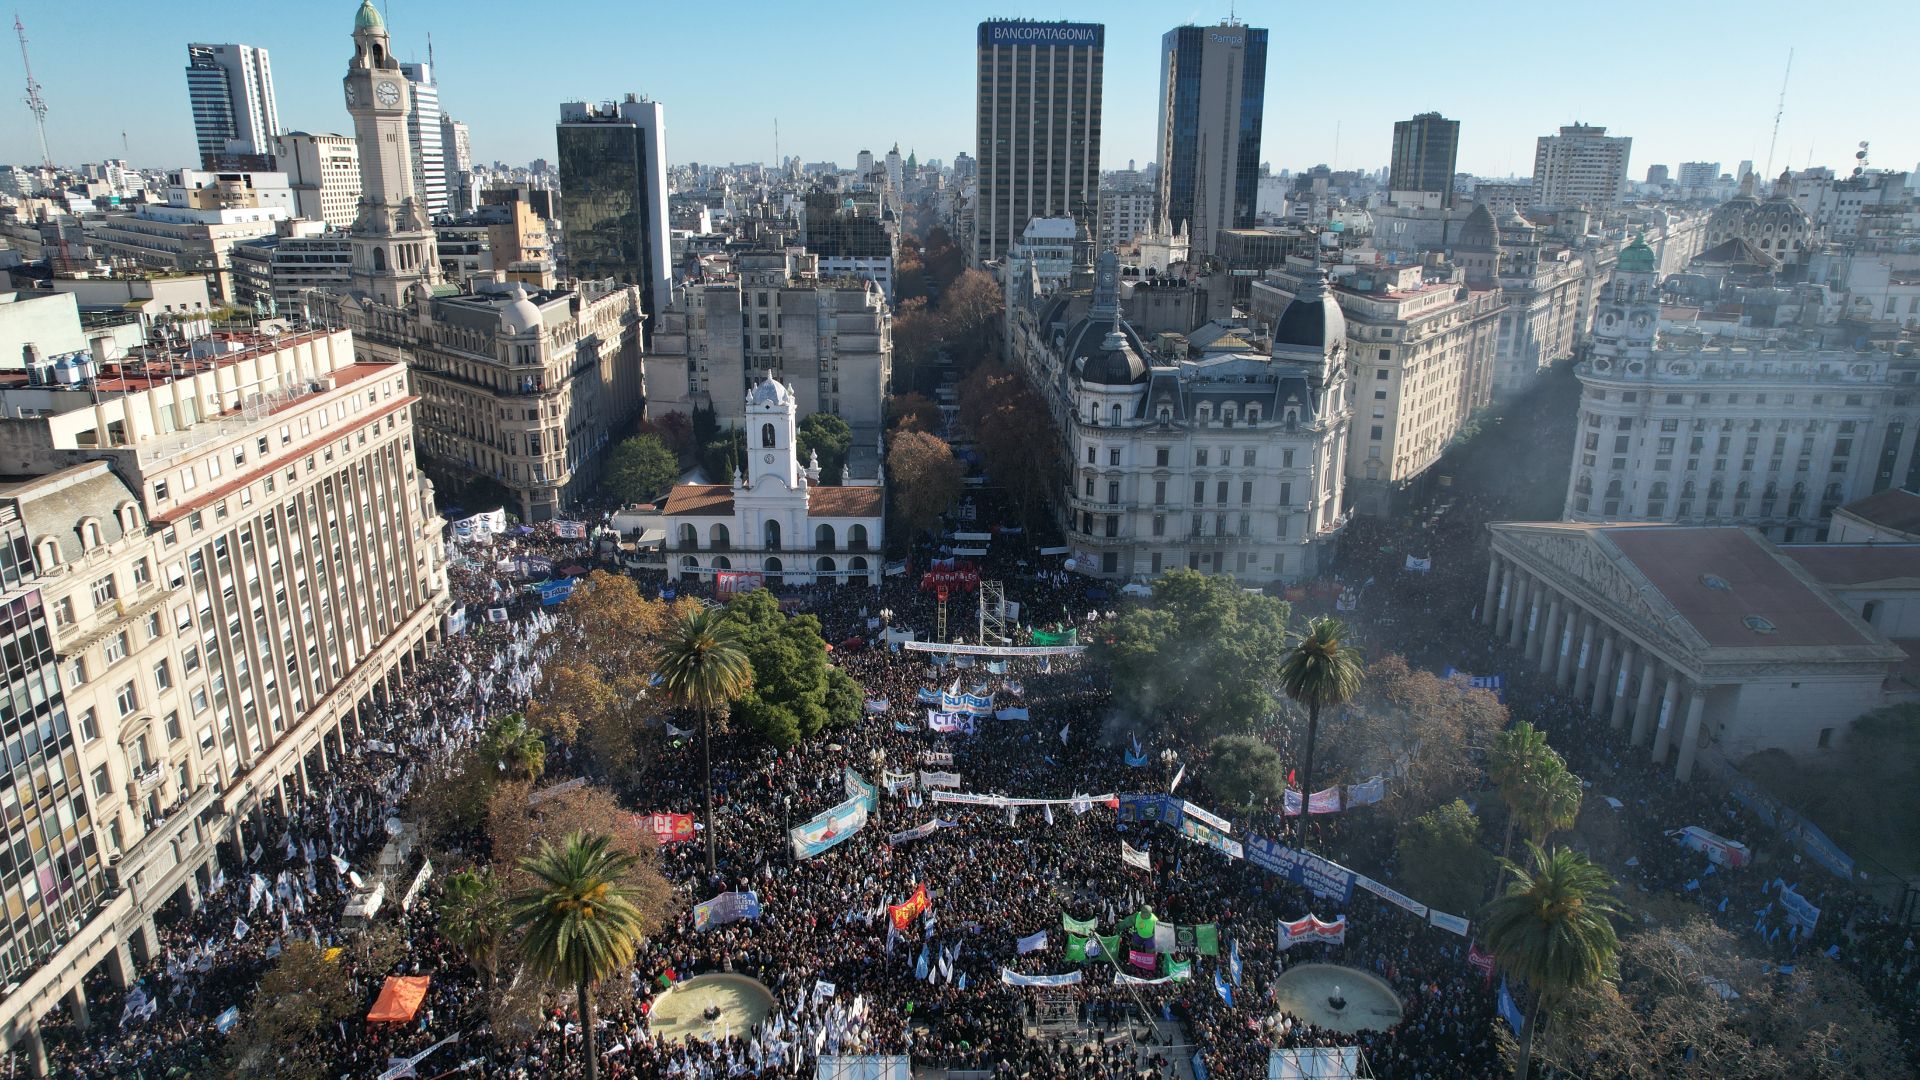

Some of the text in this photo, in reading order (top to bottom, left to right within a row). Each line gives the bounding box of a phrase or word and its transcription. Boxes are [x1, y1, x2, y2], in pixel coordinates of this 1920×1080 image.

[994, 26, 1095, 41] BANCOPATAGONIA
[1211, 33, 1243, 45] Pampa
[944, 693, 991, 708] SUTEBA
[1247, 845, 1294, 869] FERNANDO
[1247, 833, 1350, 886] LA MATANZA
[1248, 854, 1290, 878] ESPINOZA
[1303, 877, 1344, 903] MAGARIO
